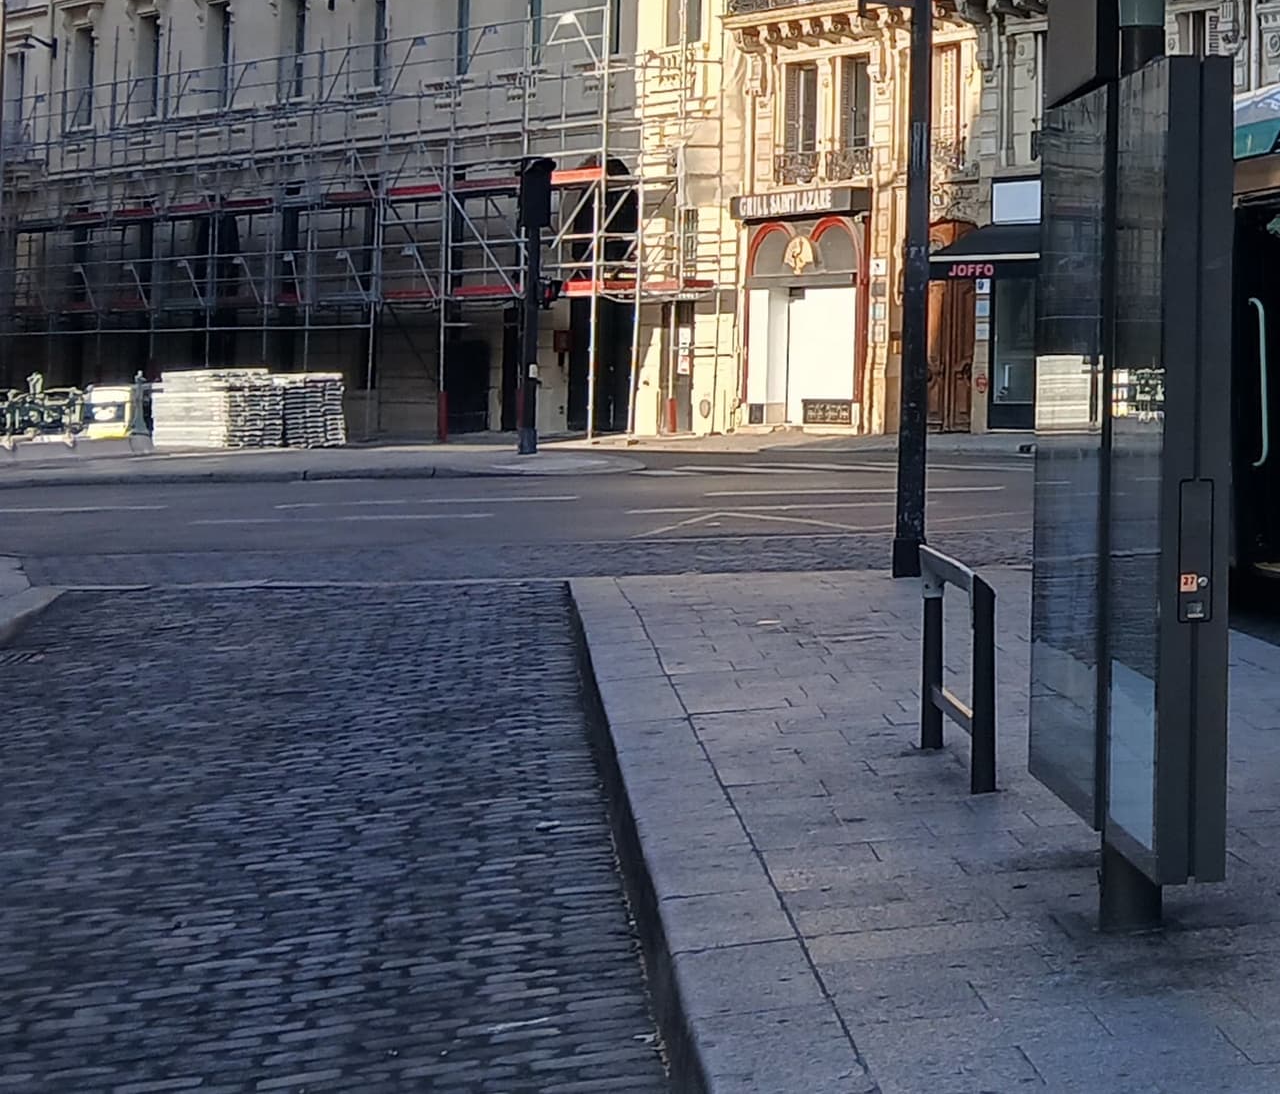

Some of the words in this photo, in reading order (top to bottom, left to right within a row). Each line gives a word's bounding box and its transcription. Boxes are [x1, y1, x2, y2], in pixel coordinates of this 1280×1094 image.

[739, 196, 769, 217] GRILL
[769, 192, 796, 216] SAINT
[796, 189, 833, 212] LAZARE
[948, 264, 994, 276] JOFFO
